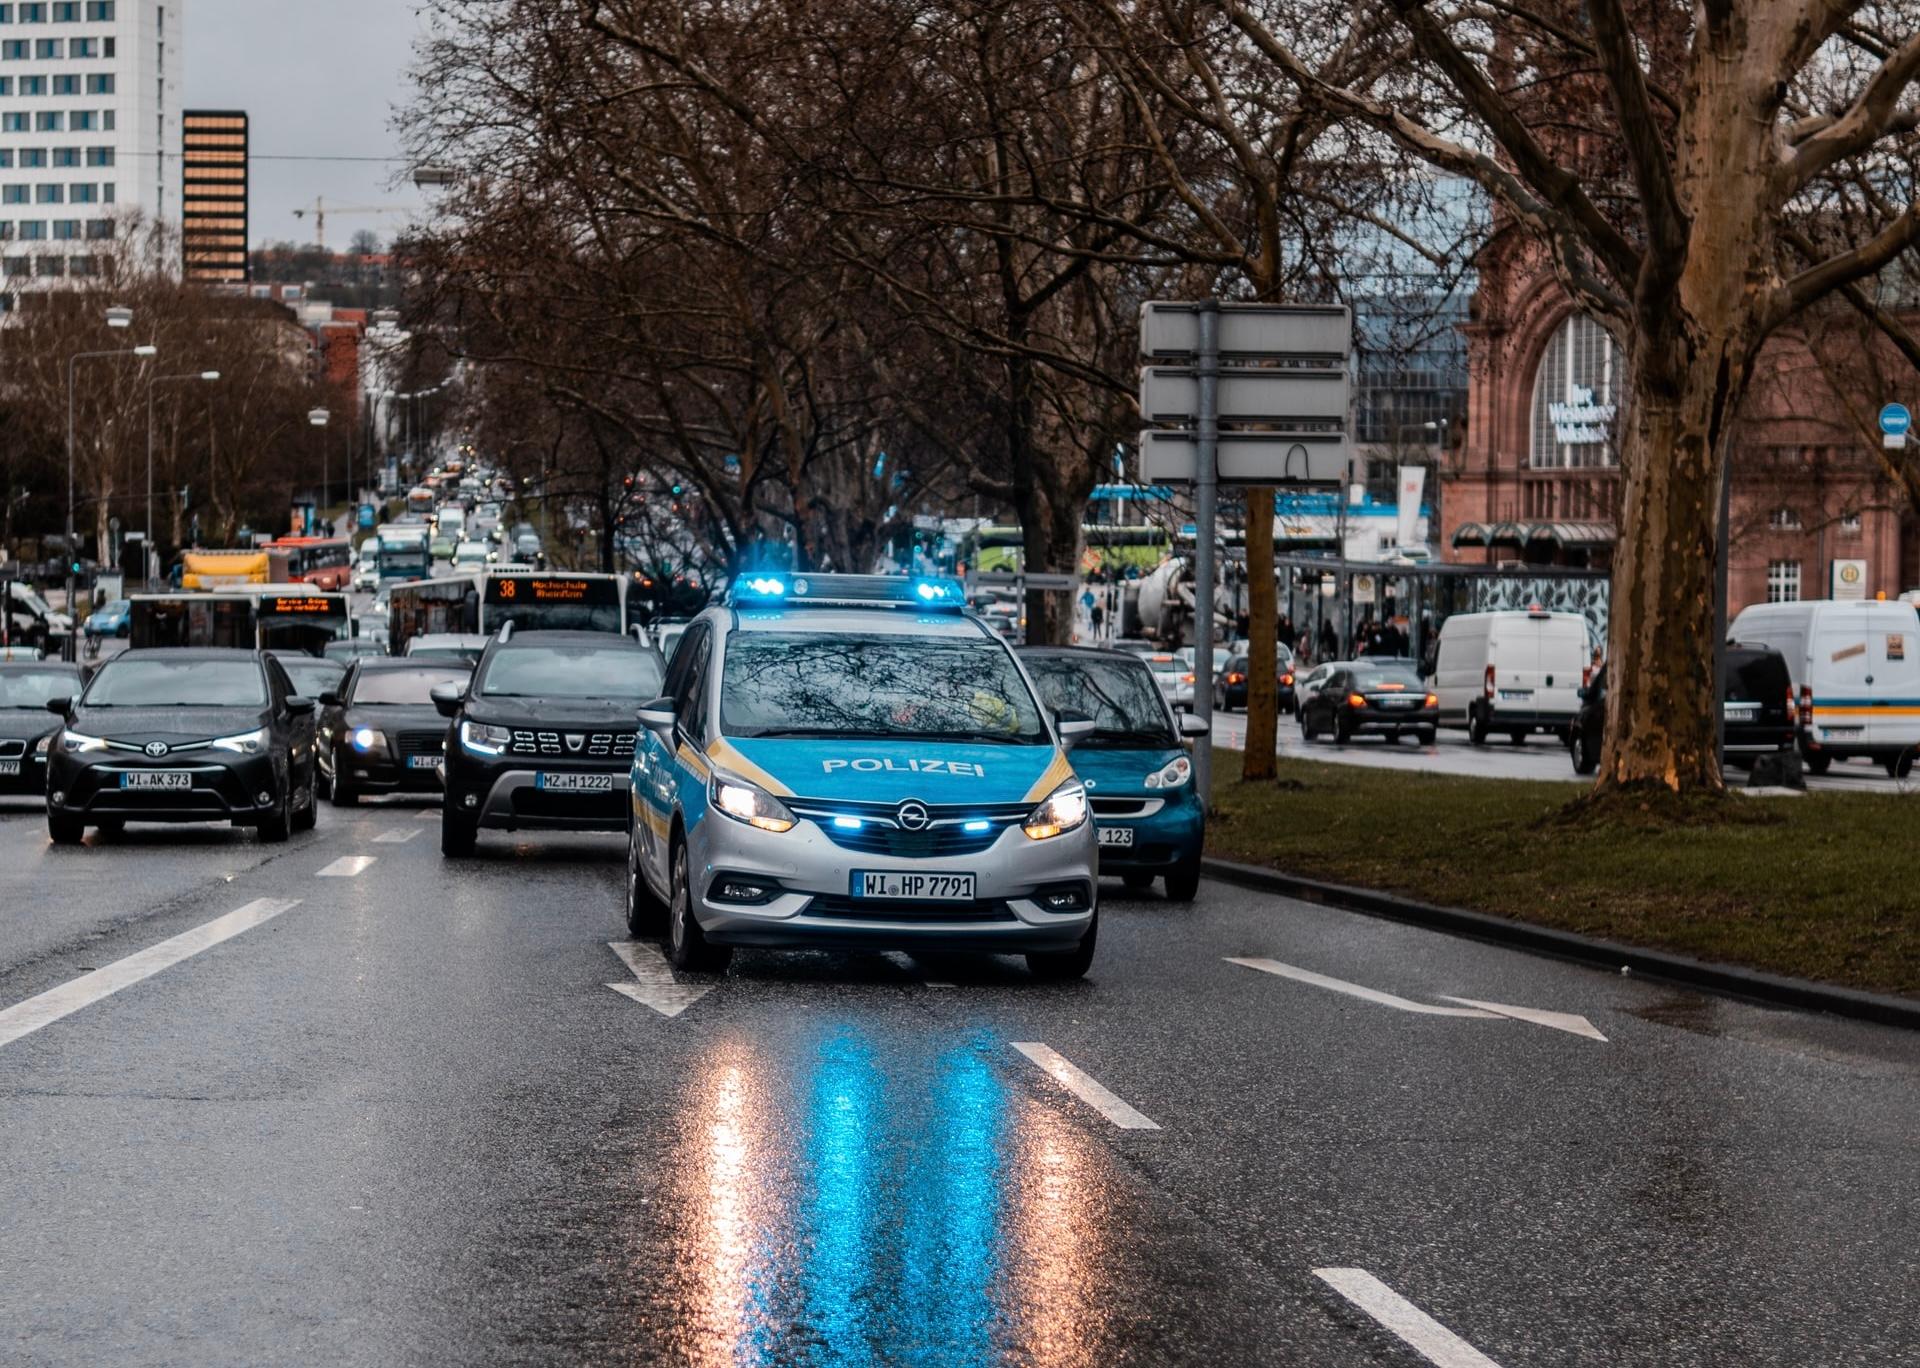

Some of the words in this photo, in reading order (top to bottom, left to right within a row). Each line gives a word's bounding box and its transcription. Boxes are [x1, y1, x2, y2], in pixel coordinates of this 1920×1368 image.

[499, 579, 516, 597] 38
[532, 580, 588, 590] Hochschule
[822, 758, 985, 777] POLIZEI
[128, 773, 142, 786] WI
[150, 773, 165, 786] AK
[167, 773, 190, 786] 373
[544, 774, 561, 788] MZ
[568, 775, 577, 788] H
[580, 775, 611, 789] 1222
[1105, 829, 1132, 844] 123
[865, 875, 886, 895] WI
[901, 876, 925, 896] HP
[928, 877, 972, 897] 7791
